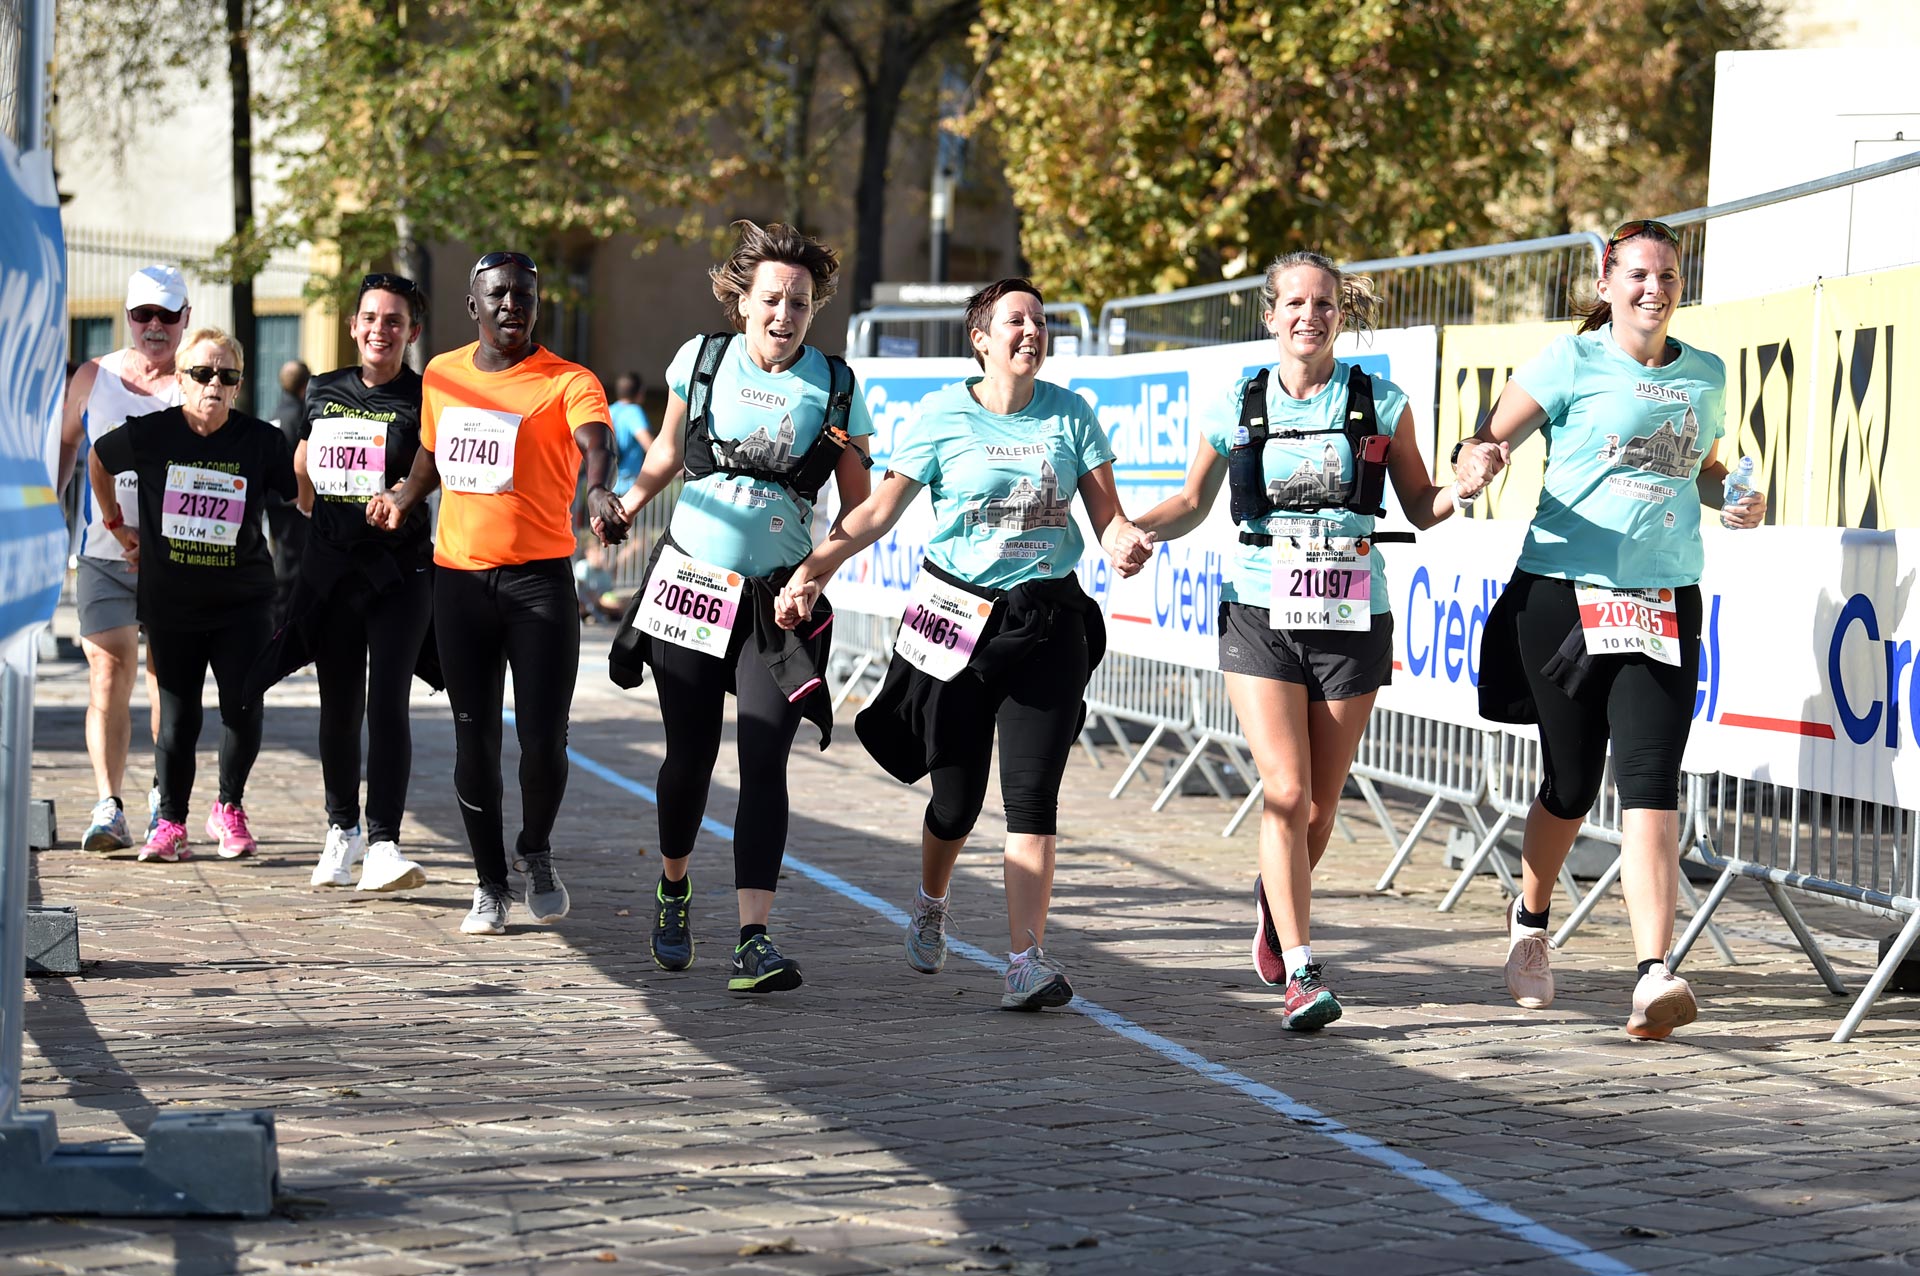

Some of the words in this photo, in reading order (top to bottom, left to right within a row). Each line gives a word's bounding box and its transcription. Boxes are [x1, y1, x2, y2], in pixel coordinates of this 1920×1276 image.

[741, 388, 786, 407] GWEN
[1636, 383, 1689, 402] JUSTINE
[319, 446, 367, 470] 21874
[449, 436, 499, 466] 21740
[985, 445, 1045, 456] VALERIE
[119, 478, 138, 488] KM
[314, 480, 326, 490] 10
[330, 481, 348, 492] KM
[445, 475, 456, 486] 10
[460, 476, 477, 488] KM
[1609, 477, 1632, 488] METZ
[1634, 482, 1673, 496] MIRABELLE
[178, 493, 229, 520] 21372
[173, 525, 186, 535] 10
[189, 527, 206, 538] KM
[1290, 519, 1336, 529] MIRABELLE
[1308, 542, 1319, 550] 14
[186, 554, 229, 566] MIRABELLE
[677, 575, 693, 583] METZ
[694, 580, 728, 592] MIRABELLE
[678, 569, 713, 583] MARATHON
[1289, 569, 1352, 597] 21097
[653, 579, 723, 625] 20666
[940, 603, 972, 619] MIRABELLE
[1286, 611, 1302, 623] 10
[1307, 612, 1330, 624] KM
[1596, 602, 1664, 635] 20285
[648, 617, 661, 632] 10
[663, 624, 687, 641] KM
[911, 604, 962, 650] 21865
[1602, 638, 1620, 649] 10
[1624, 637, 1646, 650] KM
[902, 640, 911, 655] 10
[912, 647, 927, 666] KM
